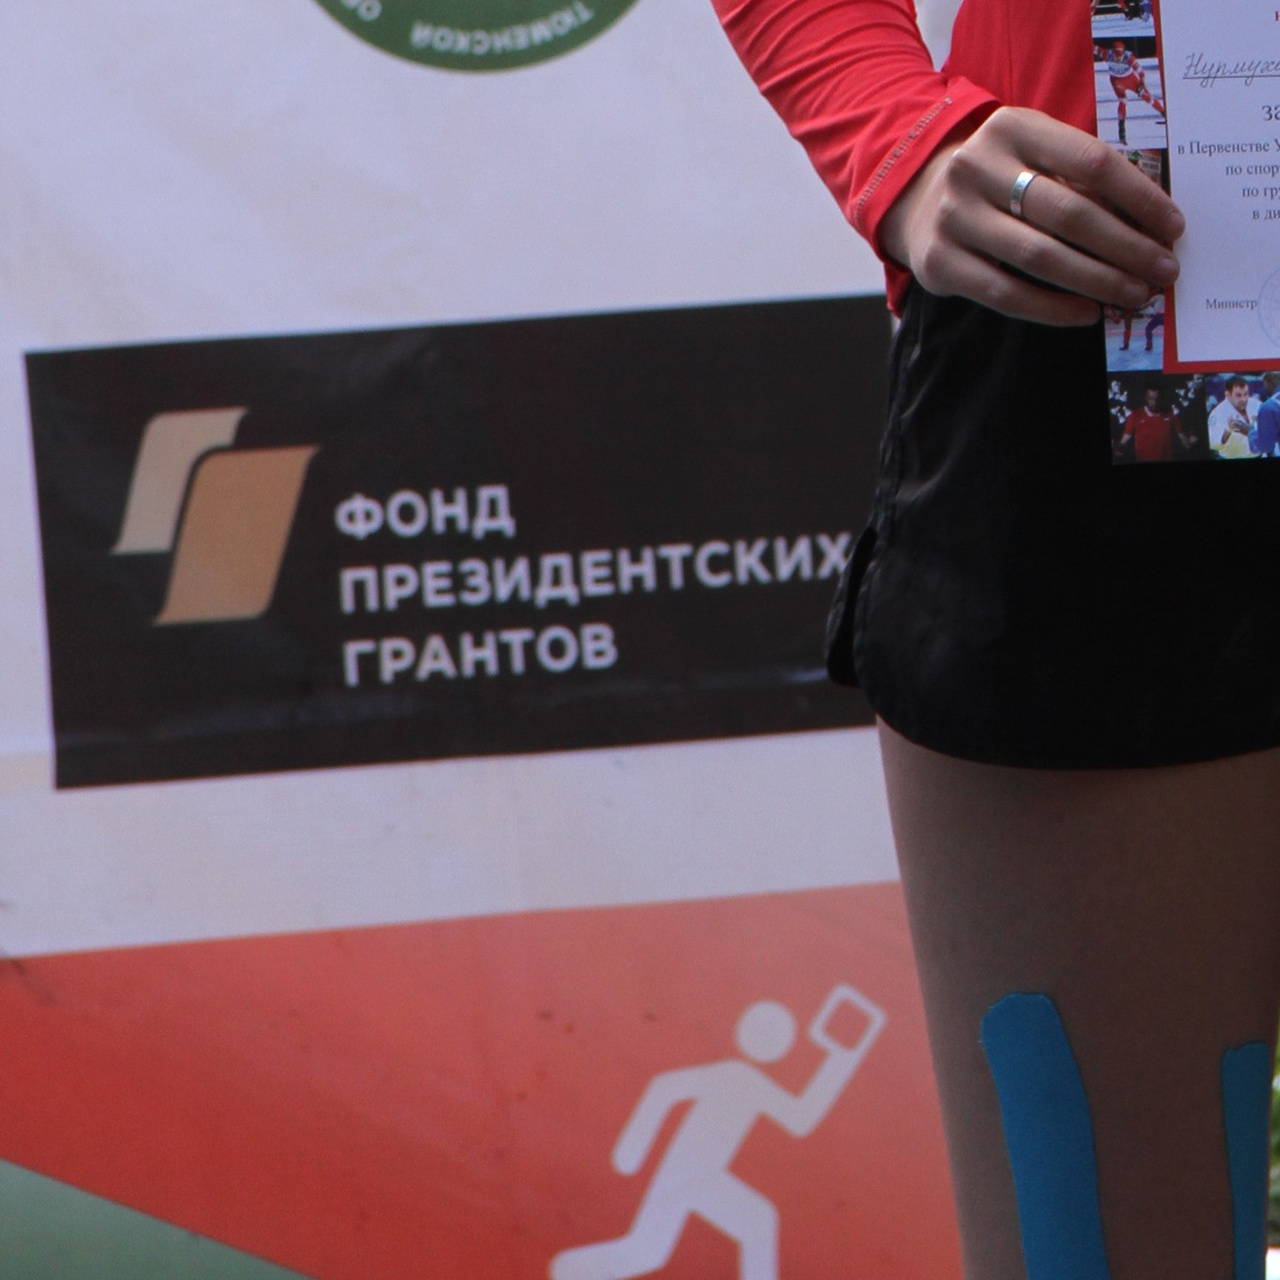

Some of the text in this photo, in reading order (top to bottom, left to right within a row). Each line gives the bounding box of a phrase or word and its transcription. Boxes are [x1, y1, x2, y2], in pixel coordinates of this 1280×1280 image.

[410, 0, 594, 55] ТЮМЕНСКОЙ
[1177, 145, 1185, 155] в
[1189, 140, 1271, 156] Первенстве
[1225, 165, 1243, 176] по
[1242, 187, 1260, 198] по
[1252, 210, 1260, 220] в
[1205, 298, 1258, 313] Министр
[335, 485, 516, 541] ФОНД
[340, 532, 852, 614] ПРЕЗИДЕНТСКИХ
[343, 623, 618, 687] ГРАНТОВ
